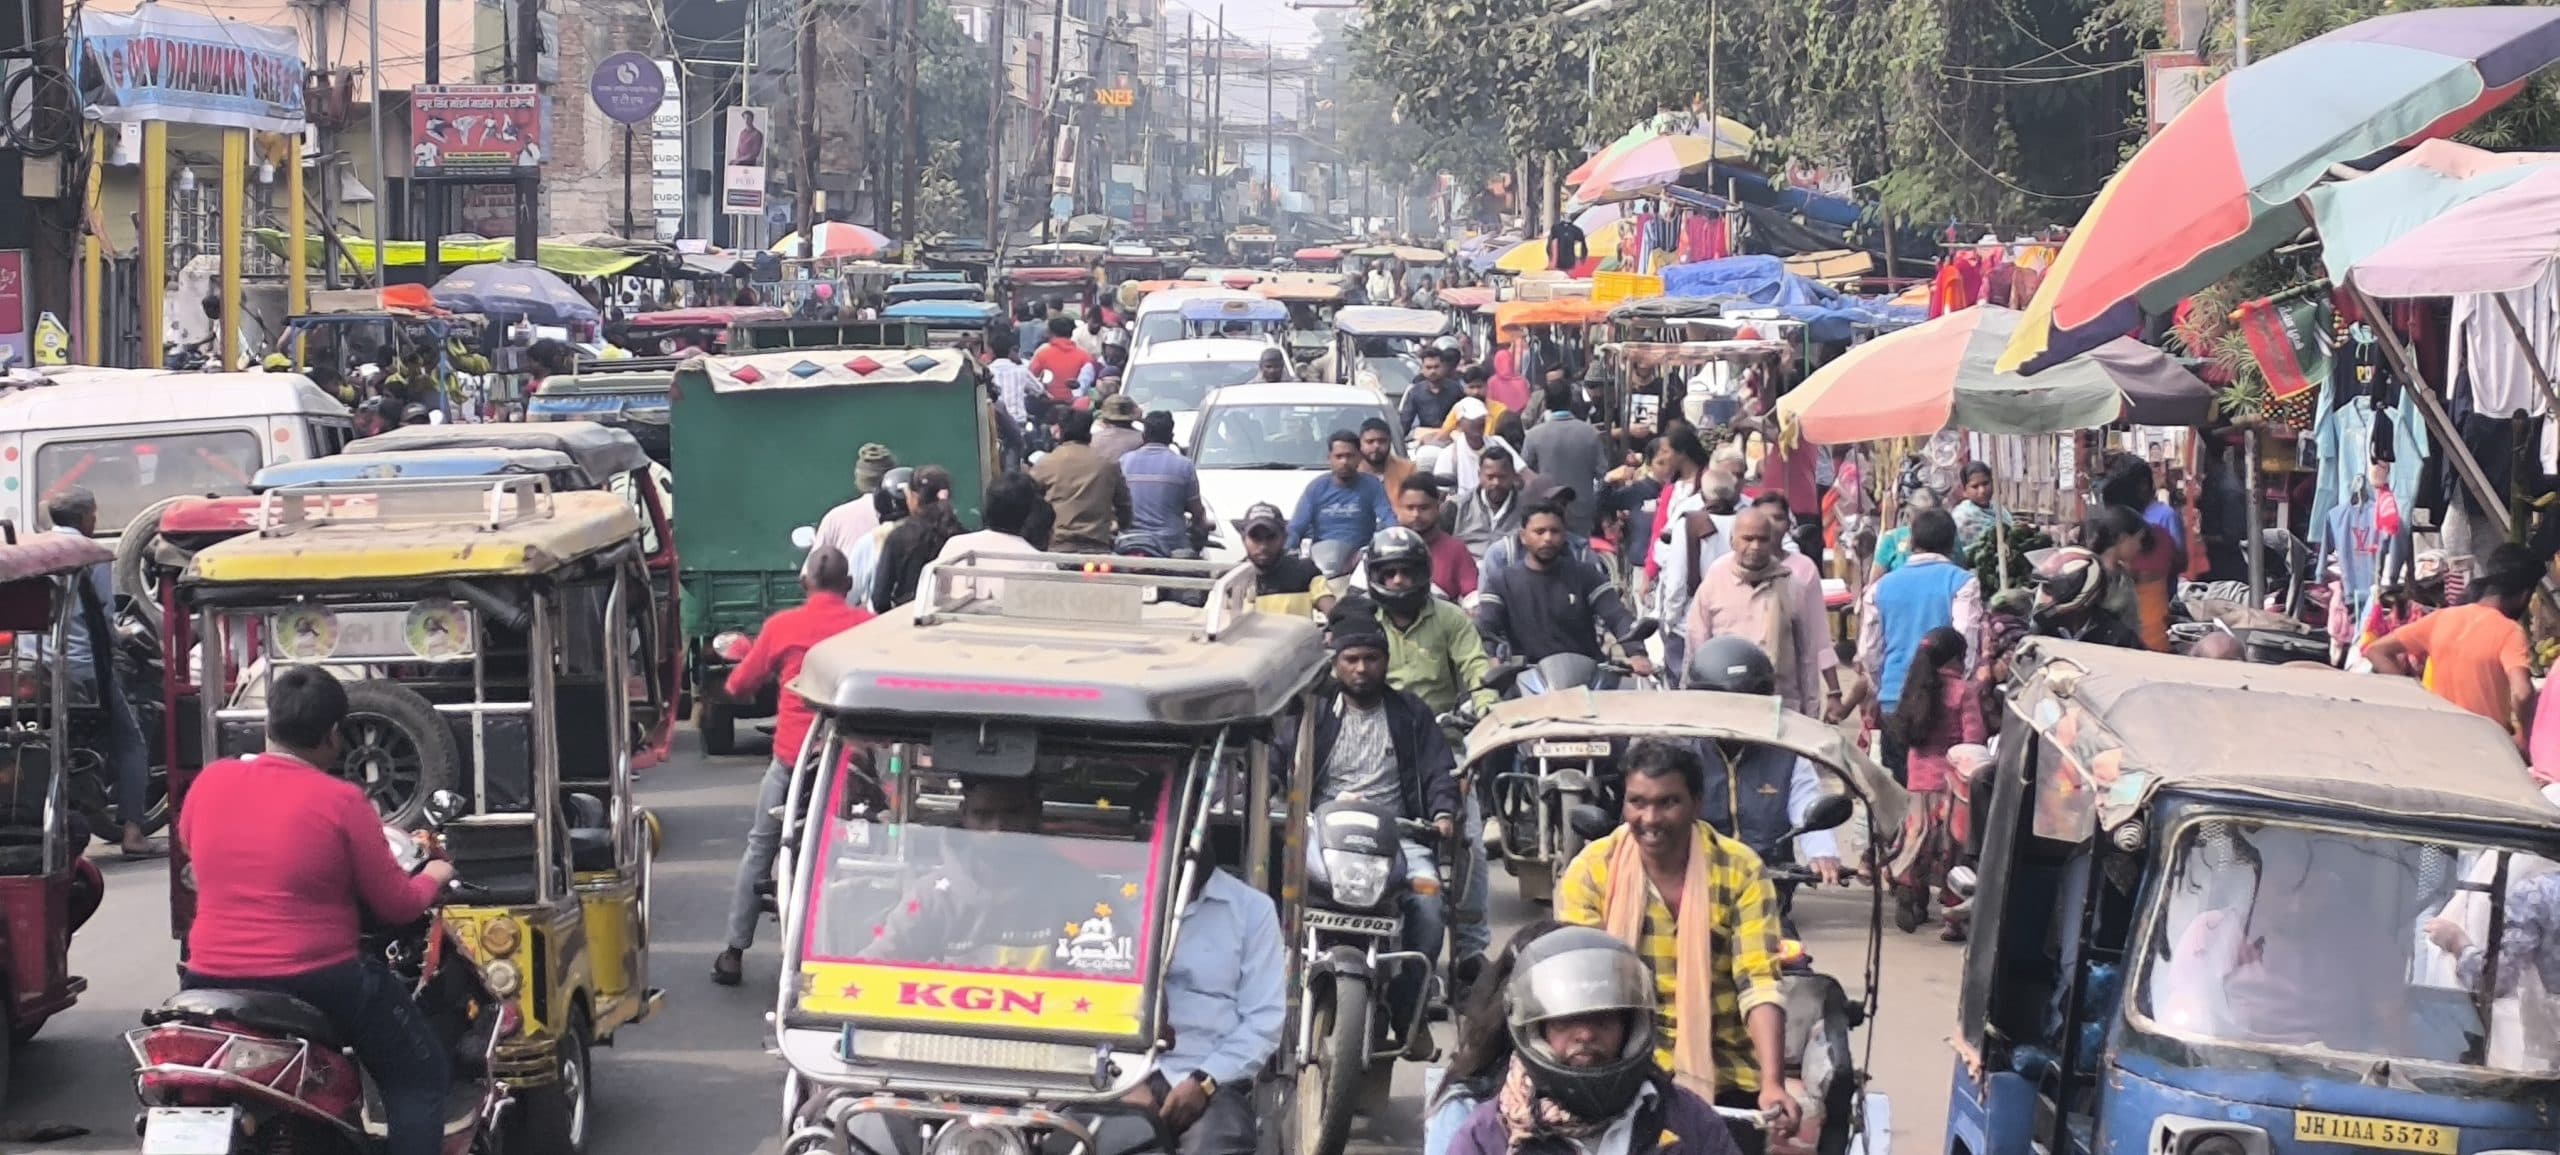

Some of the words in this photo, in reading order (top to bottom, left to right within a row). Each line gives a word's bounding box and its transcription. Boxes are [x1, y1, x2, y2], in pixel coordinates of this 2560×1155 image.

[166, 39, 246, 95] DHAMAKA
[251, 52, 282, 104] SALE
[653, 115, 680, 123] EURO
[897, 981, 1045, 1015] KGN
[2301, 1115, 2325, 1135] JH
[2331, 1119, 2375, 1141] 11AA
[2382, 1124, 2439, 1147] 5573
